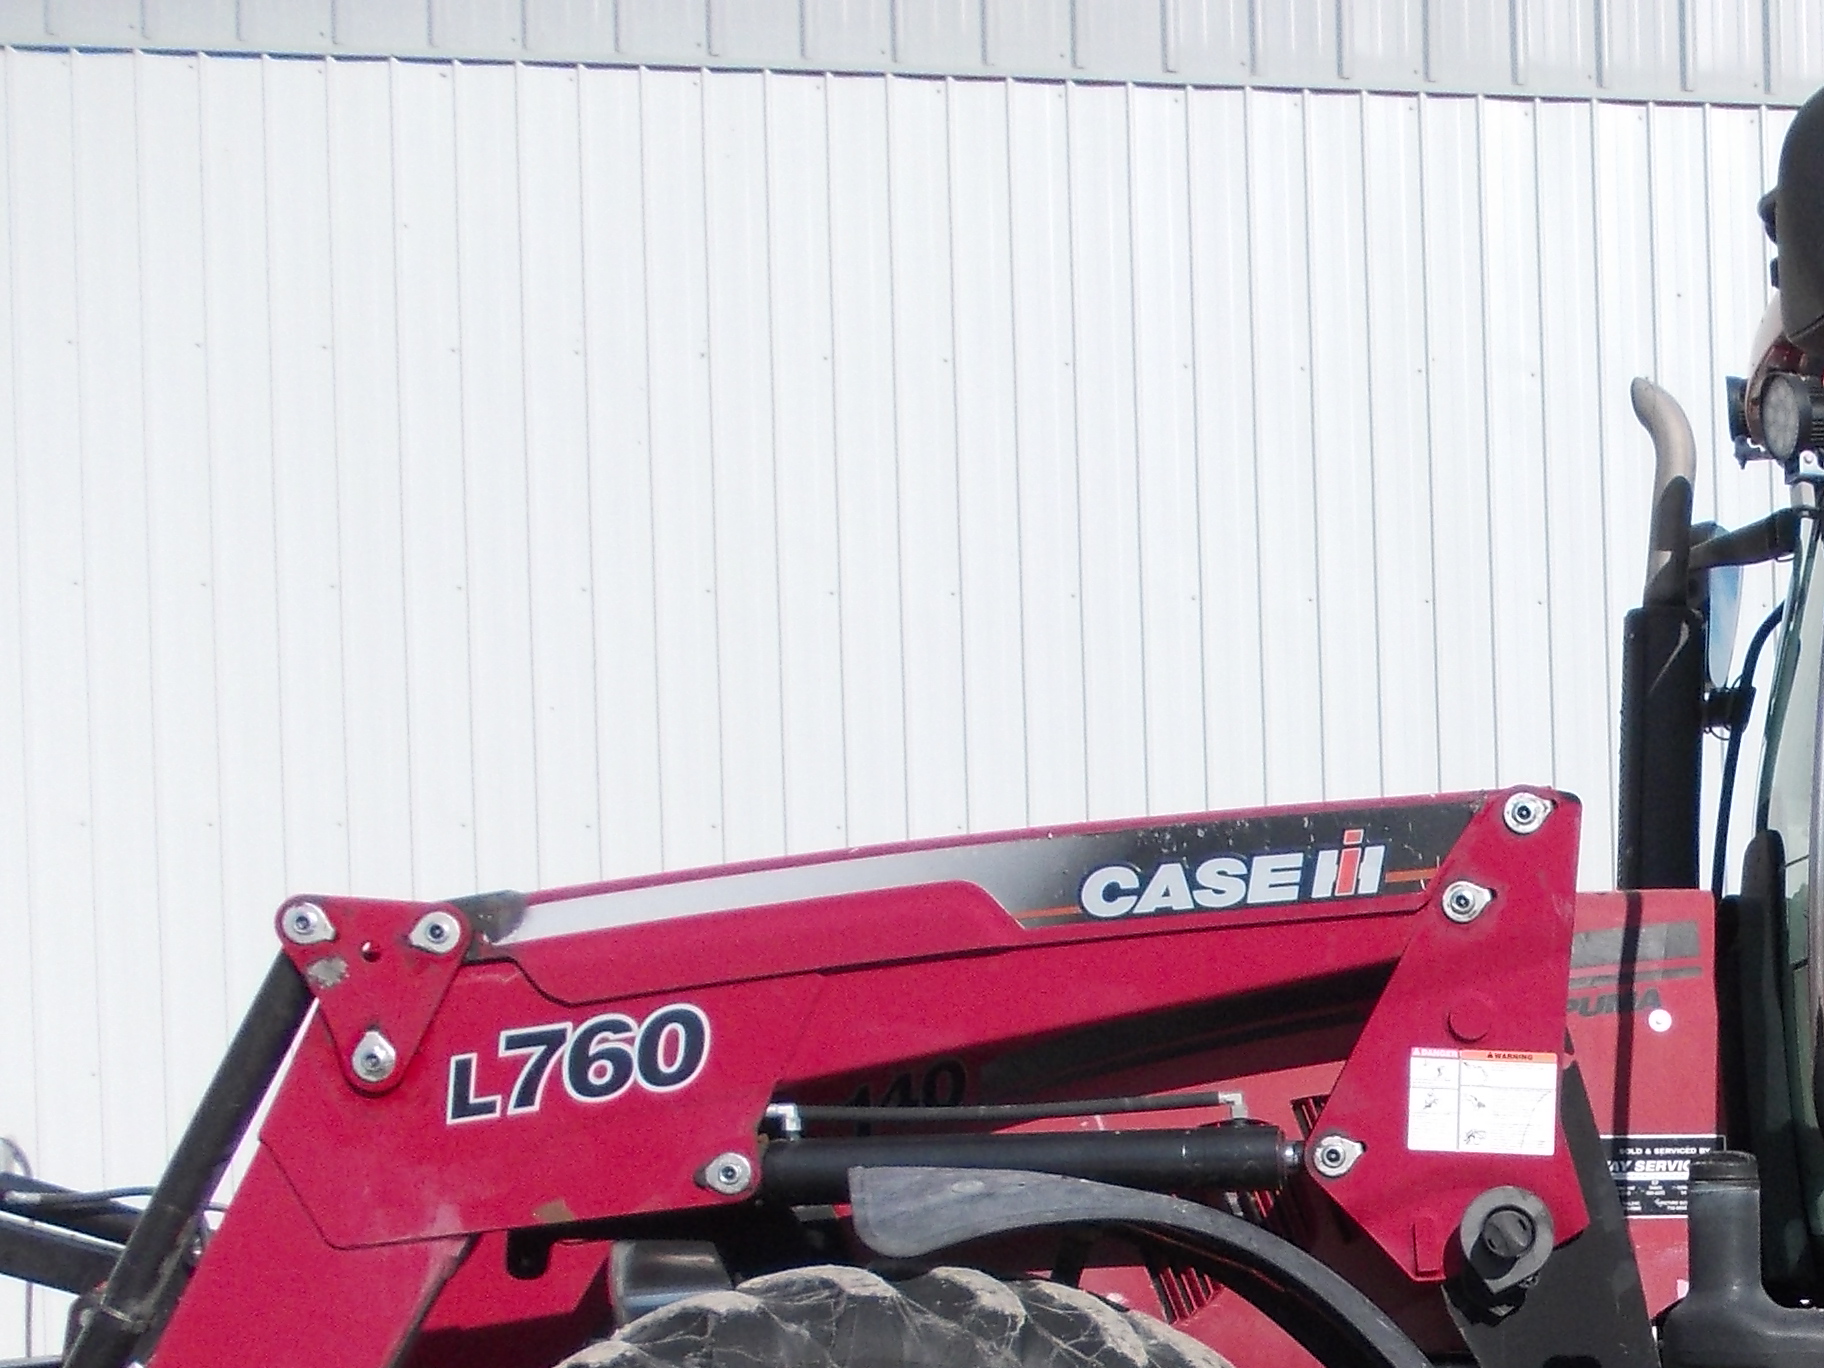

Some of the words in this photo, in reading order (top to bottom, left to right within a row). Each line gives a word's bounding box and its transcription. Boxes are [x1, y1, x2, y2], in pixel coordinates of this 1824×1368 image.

[1080, 852, 1304, 918] CASE
[1566, 987, 1662, 1018] PUMA
[1420, 1048, 1459, 1058] DANGER
[1494, 1053, 1534, 1061] WARNING
[446, 1003, 711, 1126] L760
[1619, 1147, 1643, 1155] SOLD
[1644, 1147, 1652, 1155] &
[1653, 1146, 1697, 1155] SERVICED
[1698, 1147, 1711, 1155] BY
